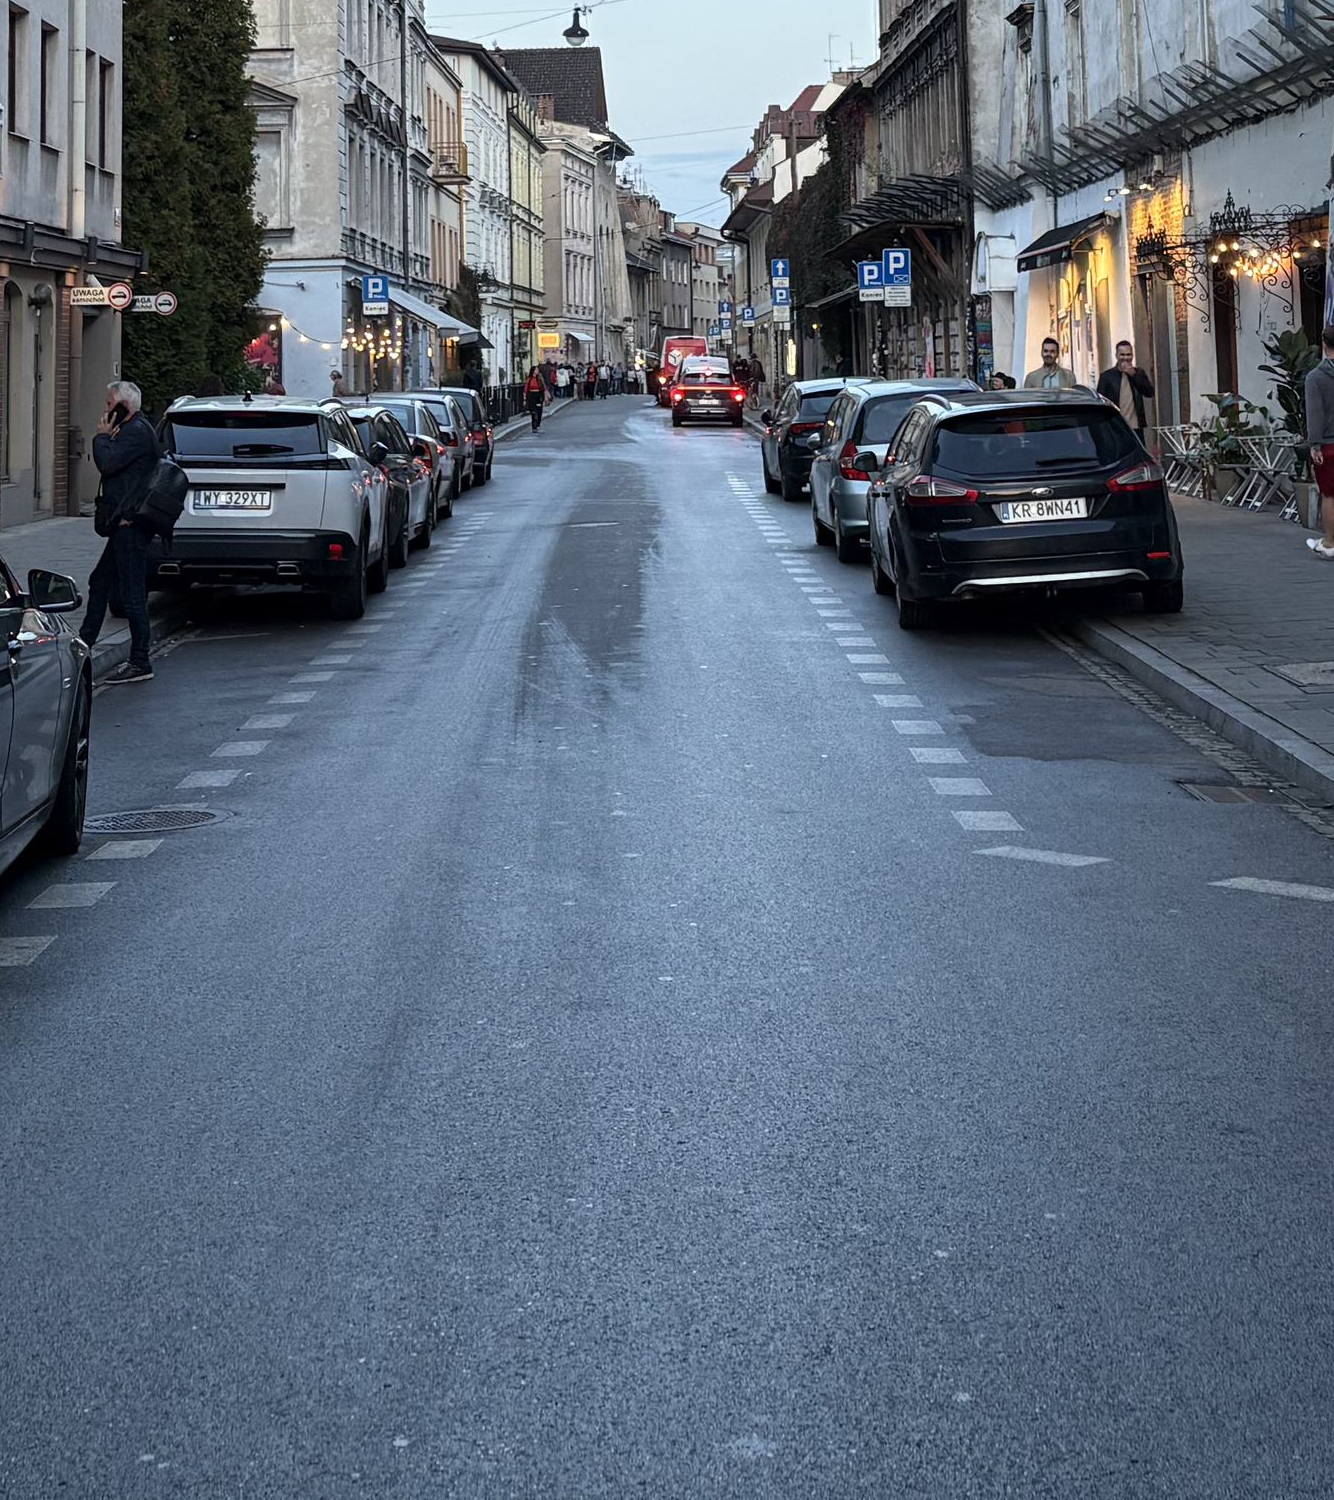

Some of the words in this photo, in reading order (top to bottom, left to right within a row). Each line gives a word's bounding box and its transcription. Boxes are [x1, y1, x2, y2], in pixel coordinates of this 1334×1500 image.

[889, 252, 905, 275] P
[863, 265, 878, 286] P
[72, 288, 105, 297] UWAGA
[368, 278, 383, 299] P
[776, 289, 787, 303] P
[744, 308, 752, 320] P
[204, 491, 220, 505] WY
[225, 491, 267, 506] 329XT
[1011, 503, 1031, 518] KR
[1036, 500, 1081, 516] 8WN41
